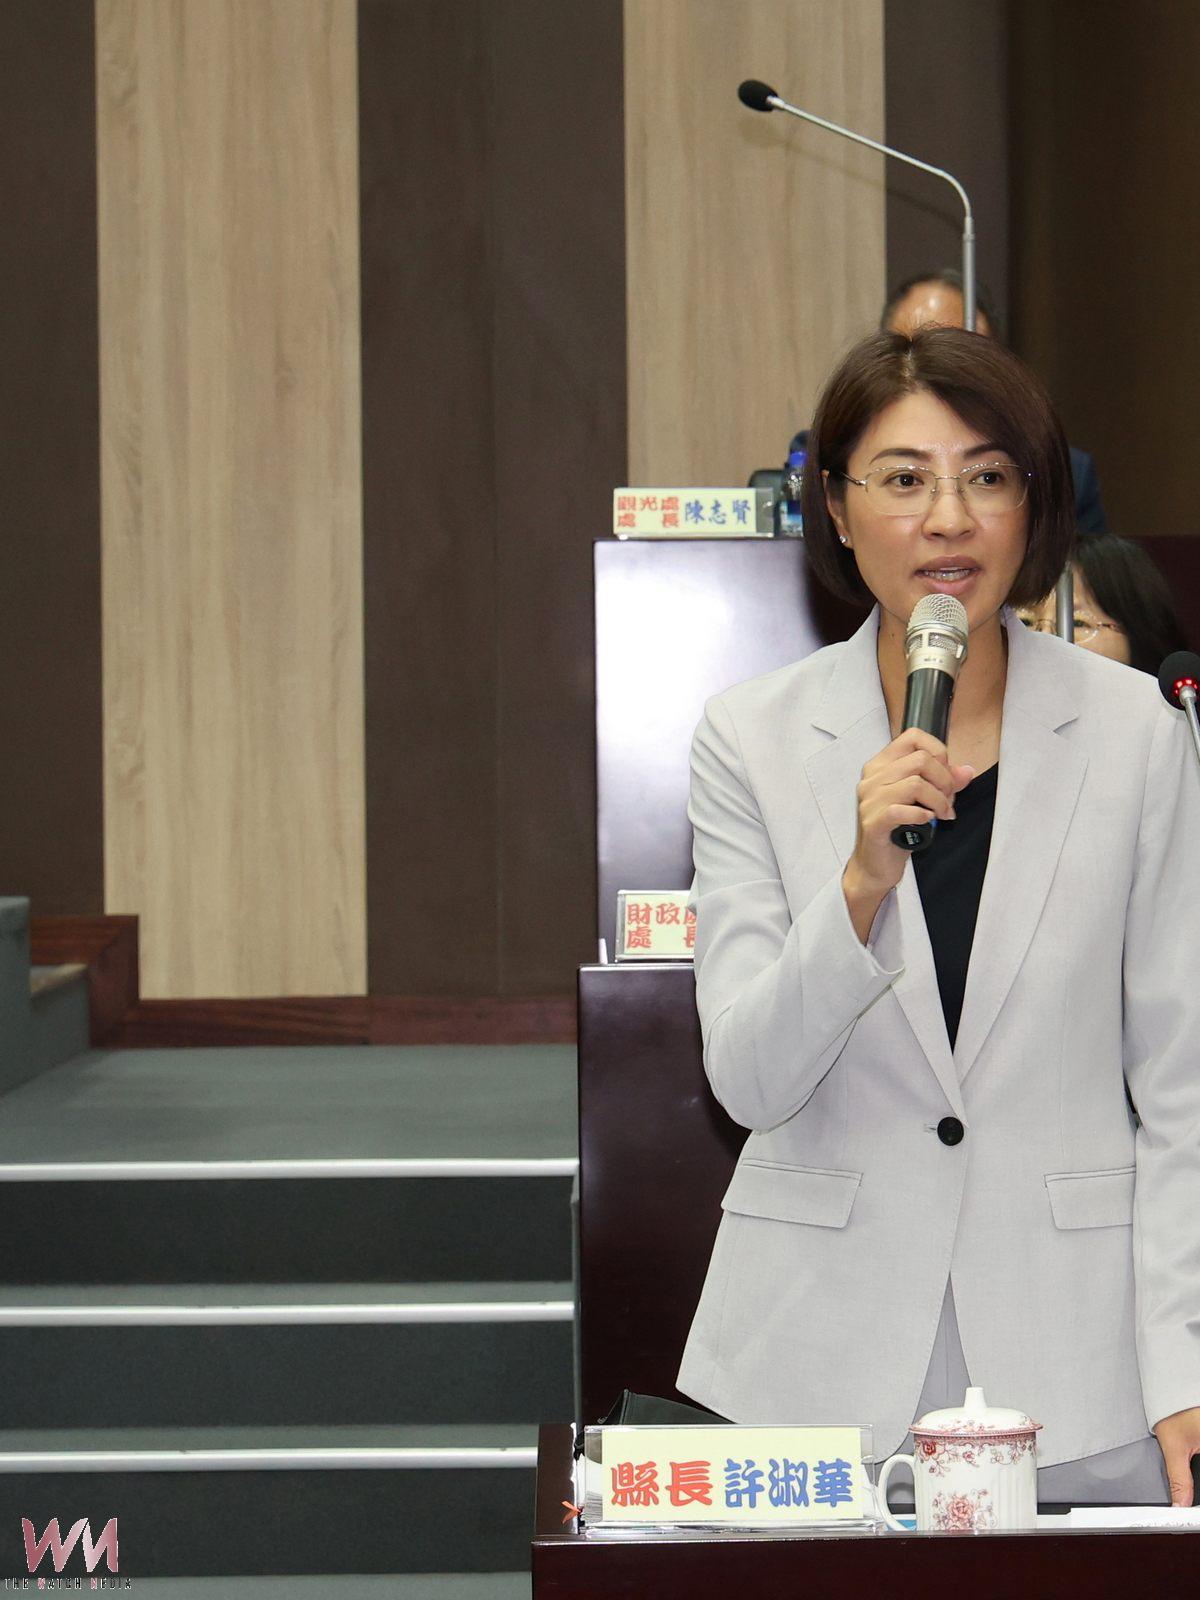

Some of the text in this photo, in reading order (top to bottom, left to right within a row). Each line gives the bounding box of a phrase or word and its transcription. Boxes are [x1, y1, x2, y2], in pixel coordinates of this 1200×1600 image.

[685, 500, 751, 524] 陳志賢
[611, 1458, 854, 1508] 縣長 許淑華
